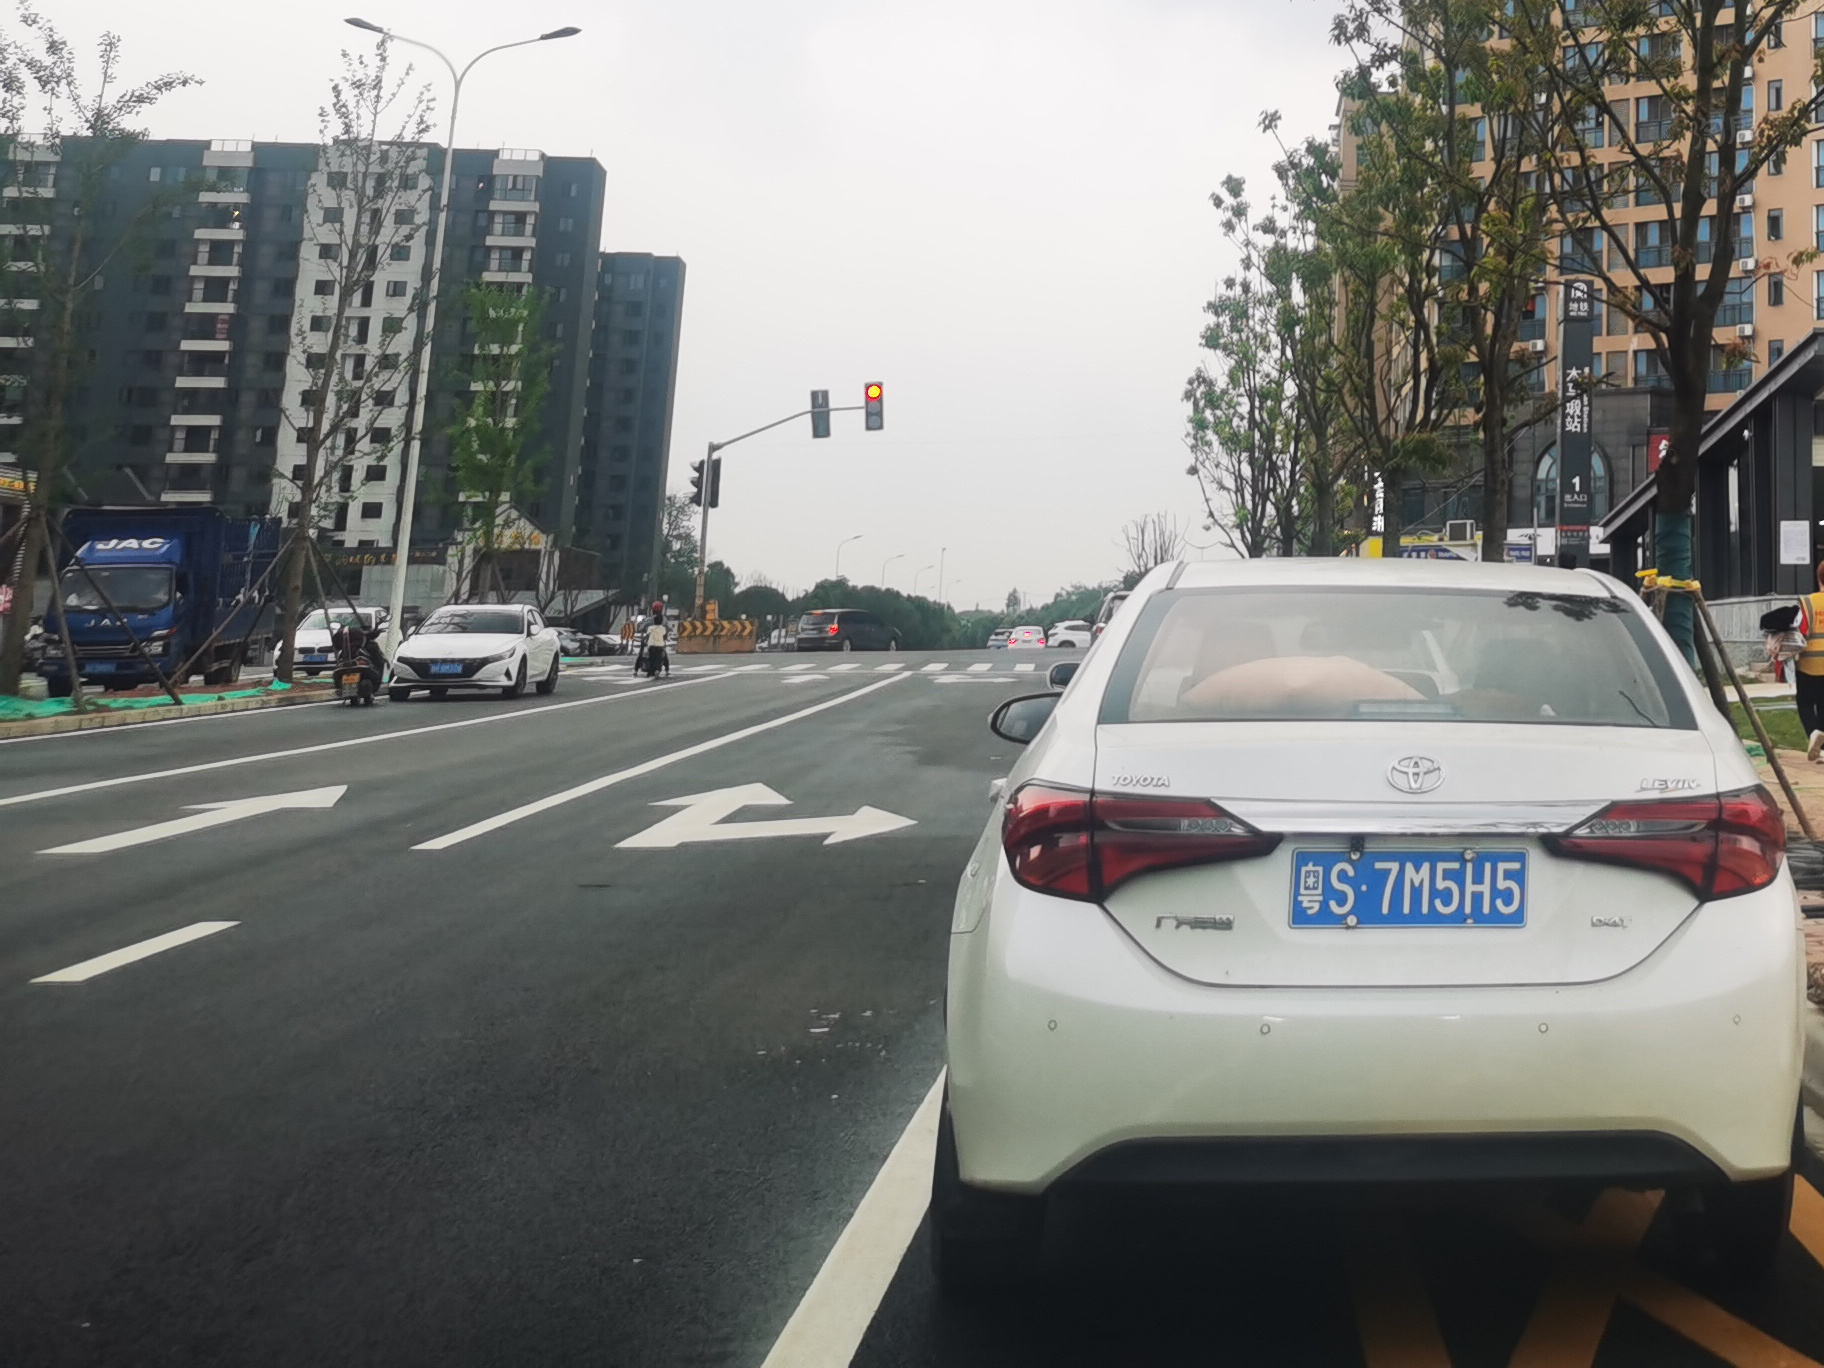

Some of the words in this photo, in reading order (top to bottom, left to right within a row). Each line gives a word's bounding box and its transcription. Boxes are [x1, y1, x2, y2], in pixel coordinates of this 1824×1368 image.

[1571, 475, 1581, 492] 1
[95, 538, 165, 549] JAC
[1111, 774, 1171, 788] TOYOTA
[1639, 777, 1699, 792] LEVIN
